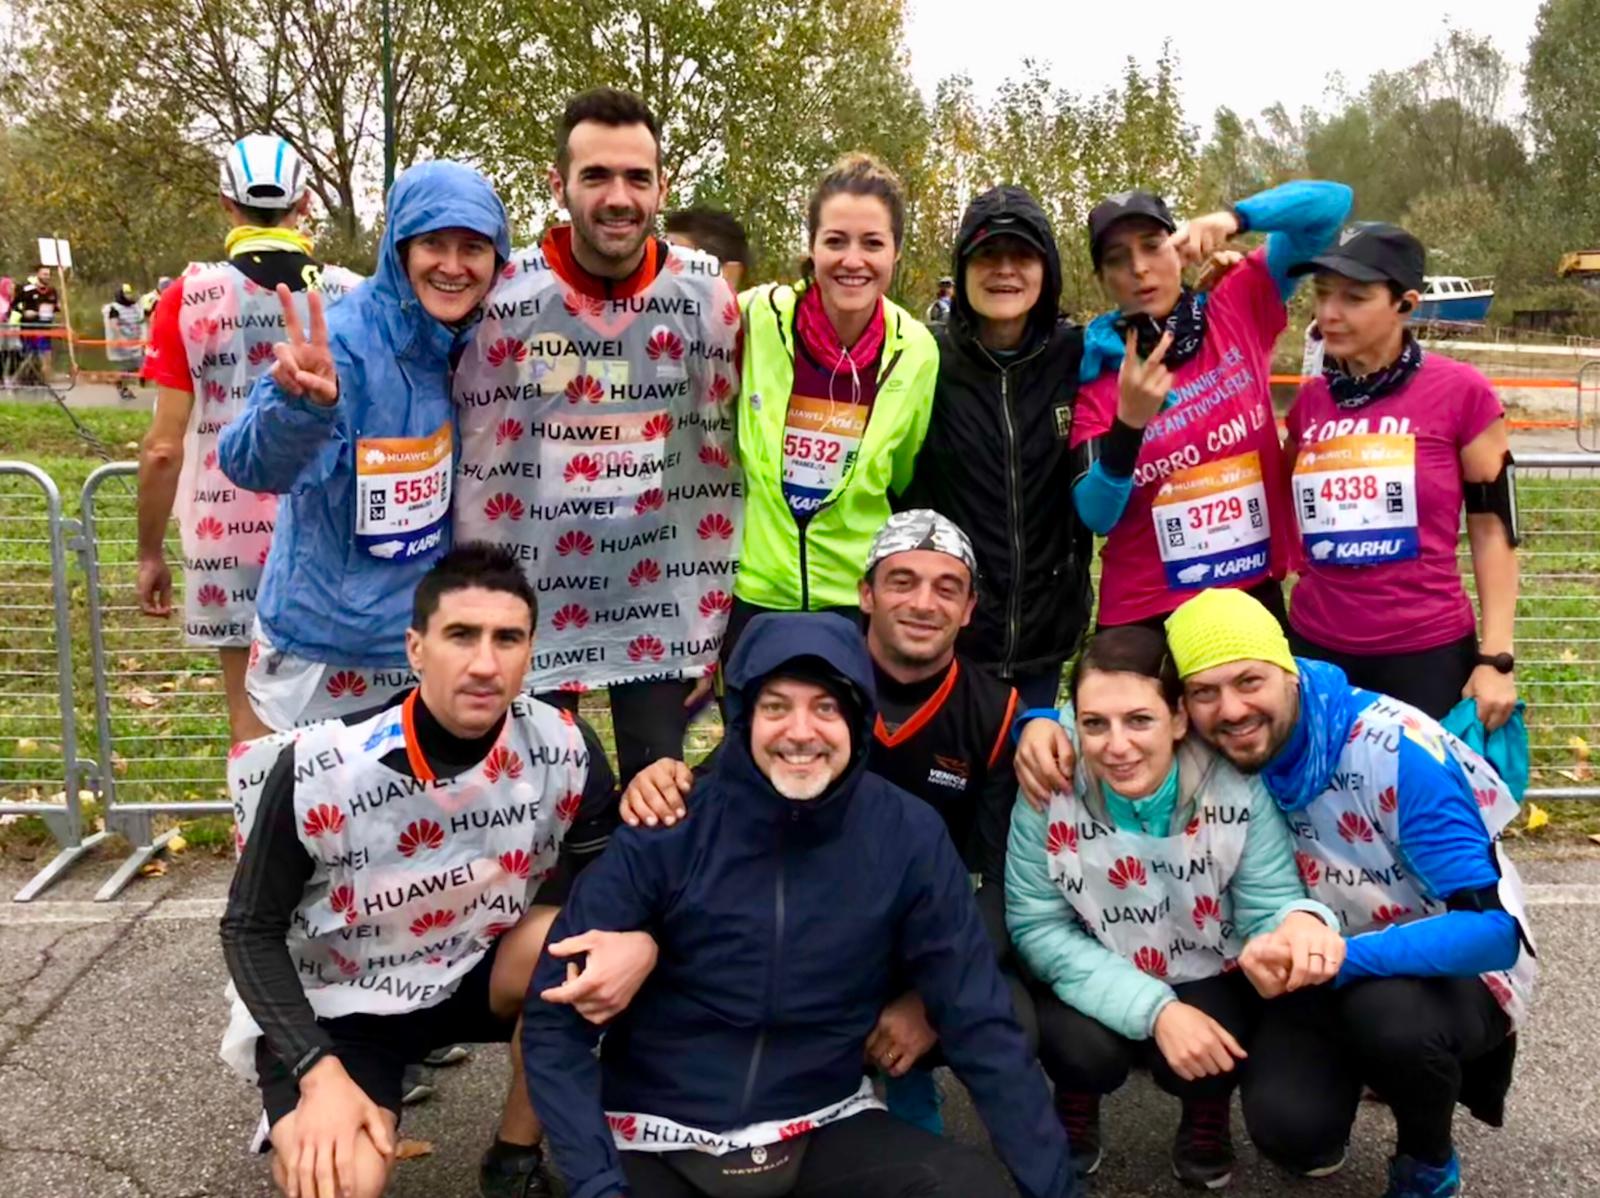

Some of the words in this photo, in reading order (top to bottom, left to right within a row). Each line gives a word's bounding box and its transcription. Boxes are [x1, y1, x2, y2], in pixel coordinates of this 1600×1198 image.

[612, 297, 700, 317] HUAWEI
[221, 314, 283, 331] HUAWE
[530, 340, 623, 357] HUAWEI
[531, 422, 620, 441] HUAWEI
[1207, 414, 1248, 452] CON
[784, 434, 841, 463] 5532
[606, 452, 681, 478] HUAWEI
[1321, 476, 1378, 501] 4338
[530, 501, 614, 521] HUAWEI
[1188, 497, 1242, 530] 3729
[600, 525, 677, 554] HUAWEI
[1336, 540, 1402, 558] KARHU
[1213, 553, 1266, 578] KARHU
[595, 603, 679, 623] HUAWEI
[364, 864, 475, 916] HUAWEI
